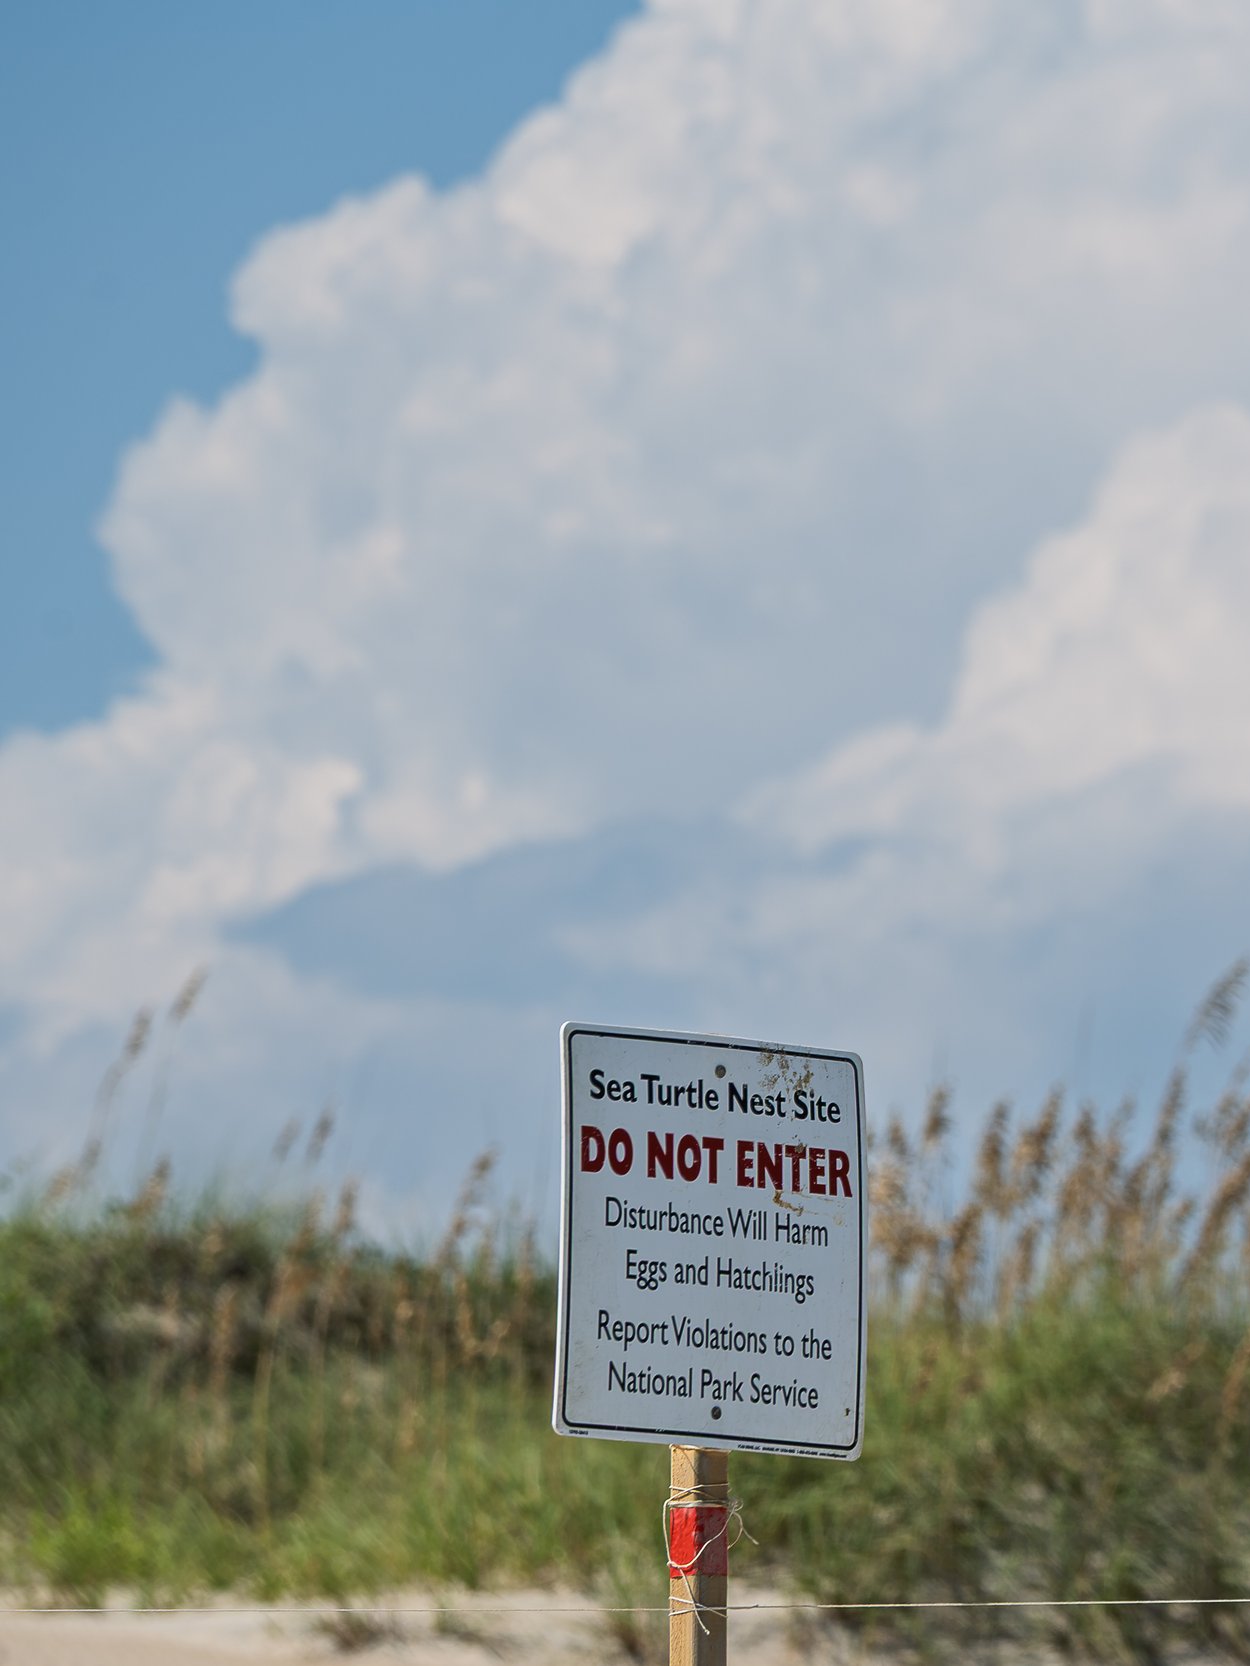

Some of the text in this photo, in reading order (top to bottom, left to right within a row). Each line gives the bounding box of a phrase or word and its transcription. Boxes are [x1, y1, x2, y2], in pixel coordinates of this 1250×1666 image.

[589, 1069, 841, 1123] Sea Turtle Nest Site
[581, 1125, 852, 1198] DO NOT ENTER
[605, 1196, 829, 1247] Disturbance Will Harm
[626, 1250, 815, 1304] Eggs and Hatchlings
[598, 1310, 832, 1360] Report Violations to the
[608, 1362, 819, 1408] National Park Service
